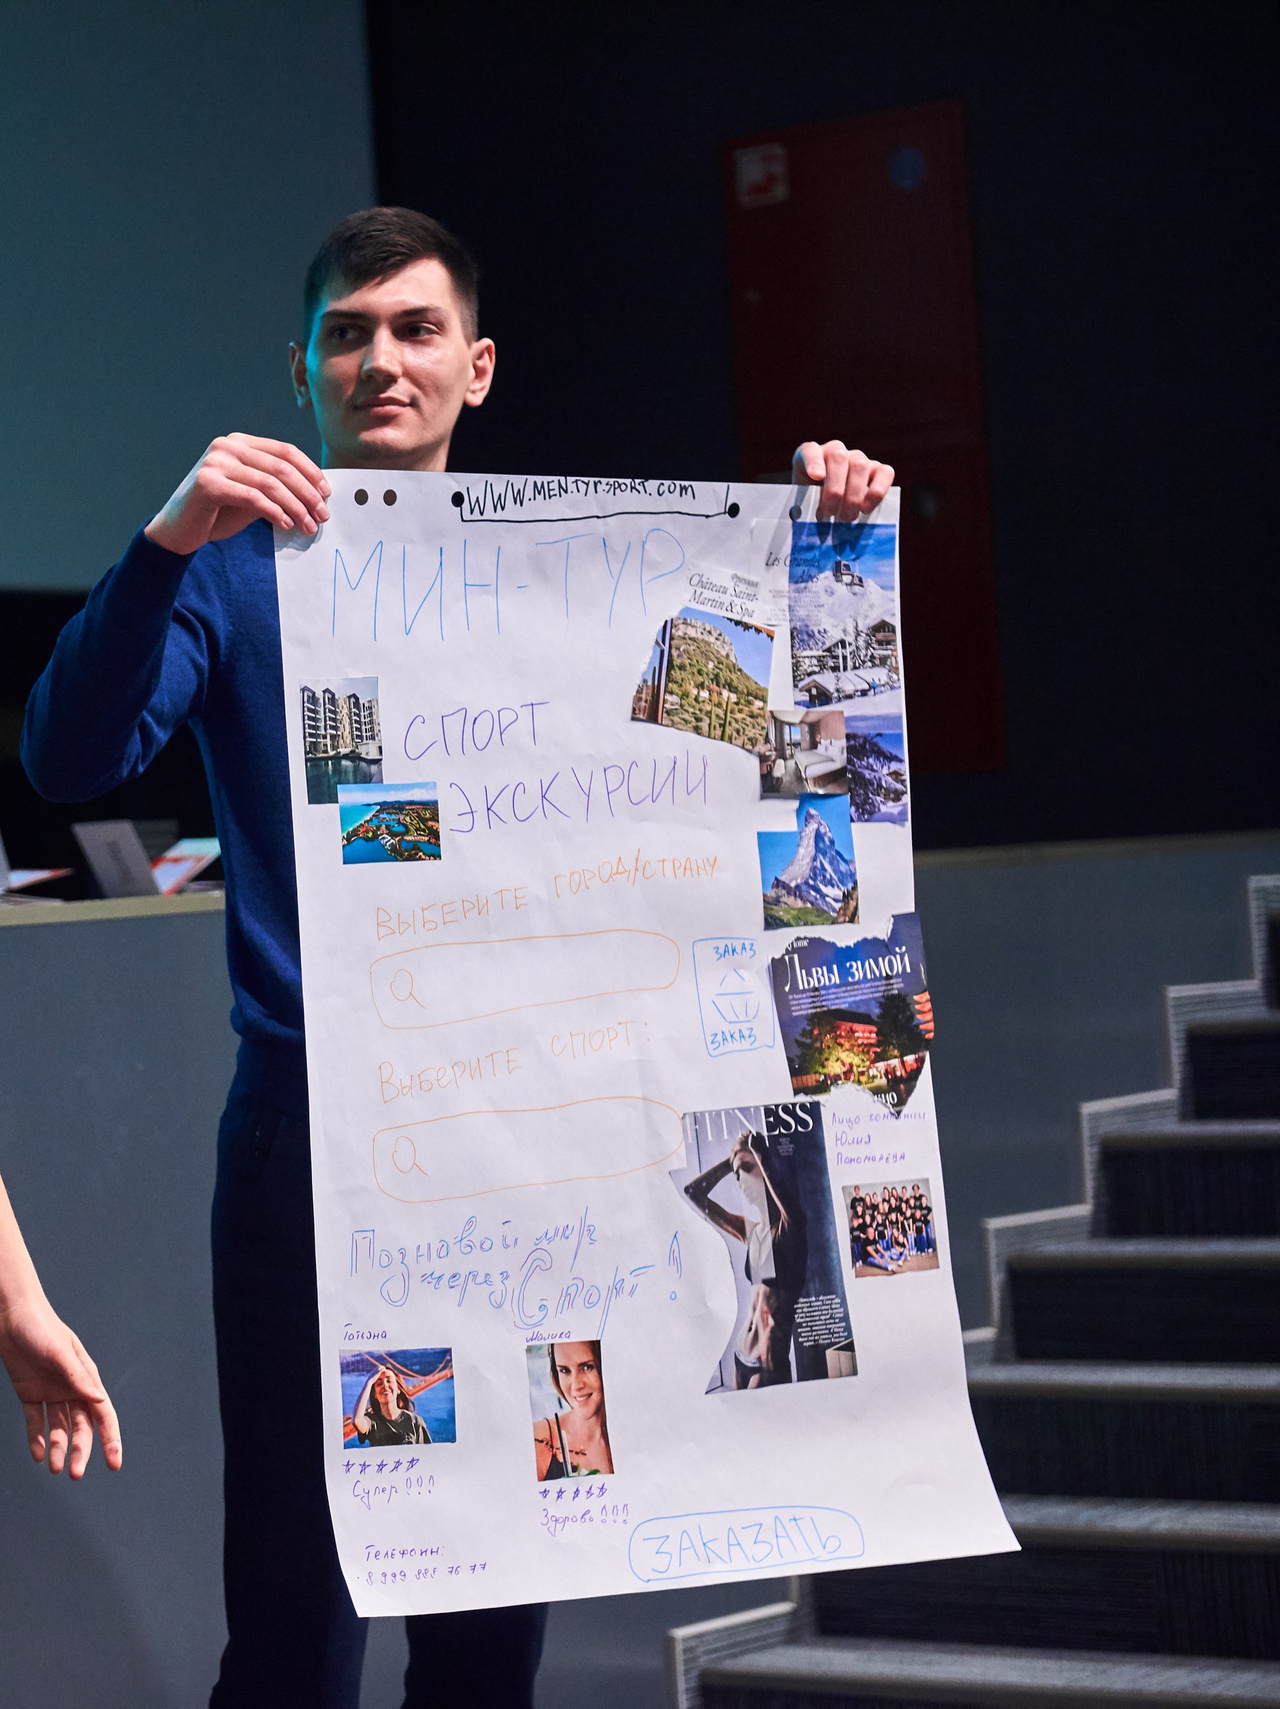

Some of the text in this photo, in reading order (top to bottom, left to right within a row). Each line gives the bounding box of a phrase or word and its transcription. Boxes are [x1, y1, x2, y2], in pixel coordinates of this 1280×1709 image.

[332, 527, 685, 641] МИН-ТУР
[688, 589, 727, 612] Martin
[725, 599, 738, 613] &
[737, 602, 755, 621] Spa
[403, 701, 550, 762] СПОРТ
[448, 749, 708, 832] ЭКСКУРСИИ
[375, 886, 529, 941] ВЫБЕРИТЕ
[713, 942, 757, 961] ЗАКАЗ
[710, 1027, 757, 1051] ЗАКАЗ
[684, 1101, 814, 1143] FITNESS
[835, 1130, 872, 1147] Юлия
[642, 1515, 842, 1574] ЗАКАЗАТЬ
[447, 1565, 462, 1576] 76
[469, 1562, 488, 1574] 77
